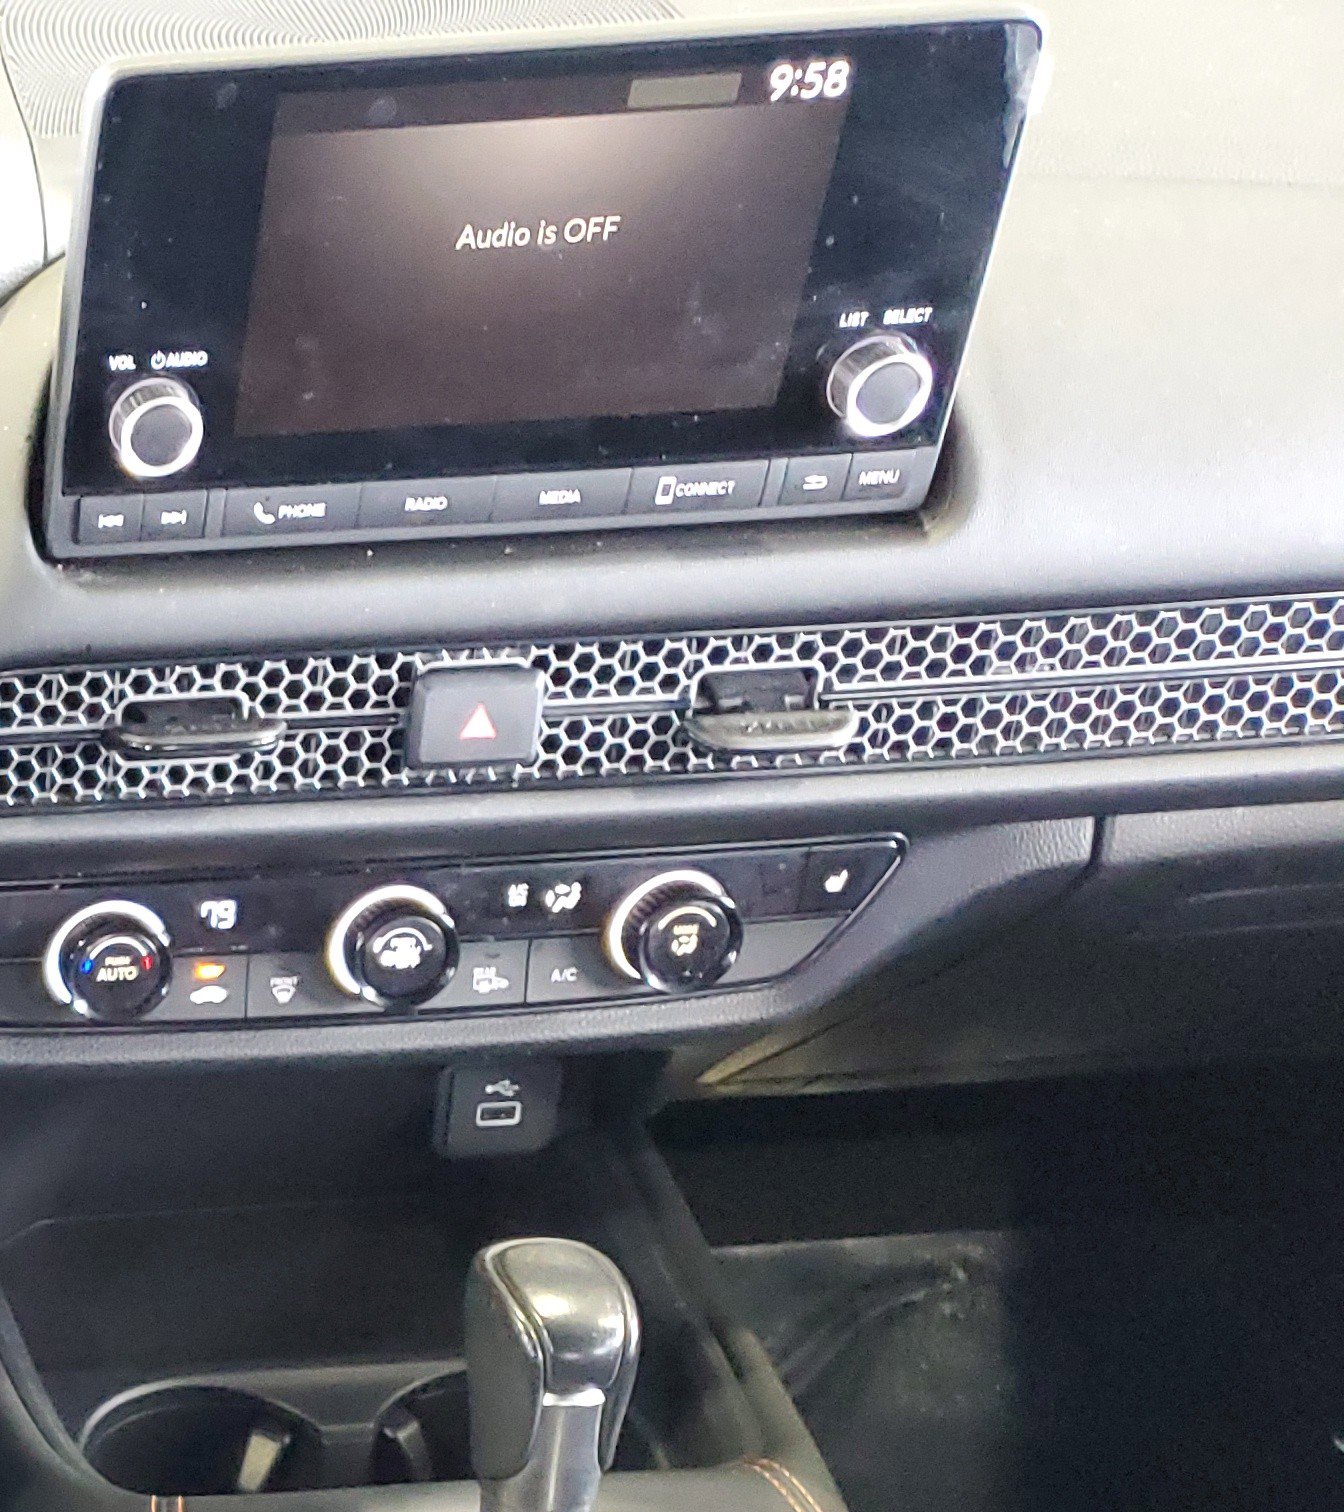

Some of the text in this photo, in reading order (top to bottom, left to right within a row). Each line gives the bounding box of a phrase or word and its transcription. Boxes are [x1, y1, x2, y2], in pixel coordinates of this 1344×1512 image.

[769, 60, 850, 102] 9:58
[455, 215, 622, 250] Audio is OFF
[839, 311, 869, 328] LIST
[883, 307, 933, 325] SELECT
[109, 354, 136, 371] VOL
[165, 350, 208, 368] AUDIO
[859, 469, 900, 486] MENU
[539, 489, 582, 505] MEDIA
[675, 480, 736, 498] CONNECT
[278, 502, 327, 519] PHONE
[405, 495, 448, 512] RADIO
[96, 965, 139, 982] AUTO
[551, 966, 577, 983] A/C
